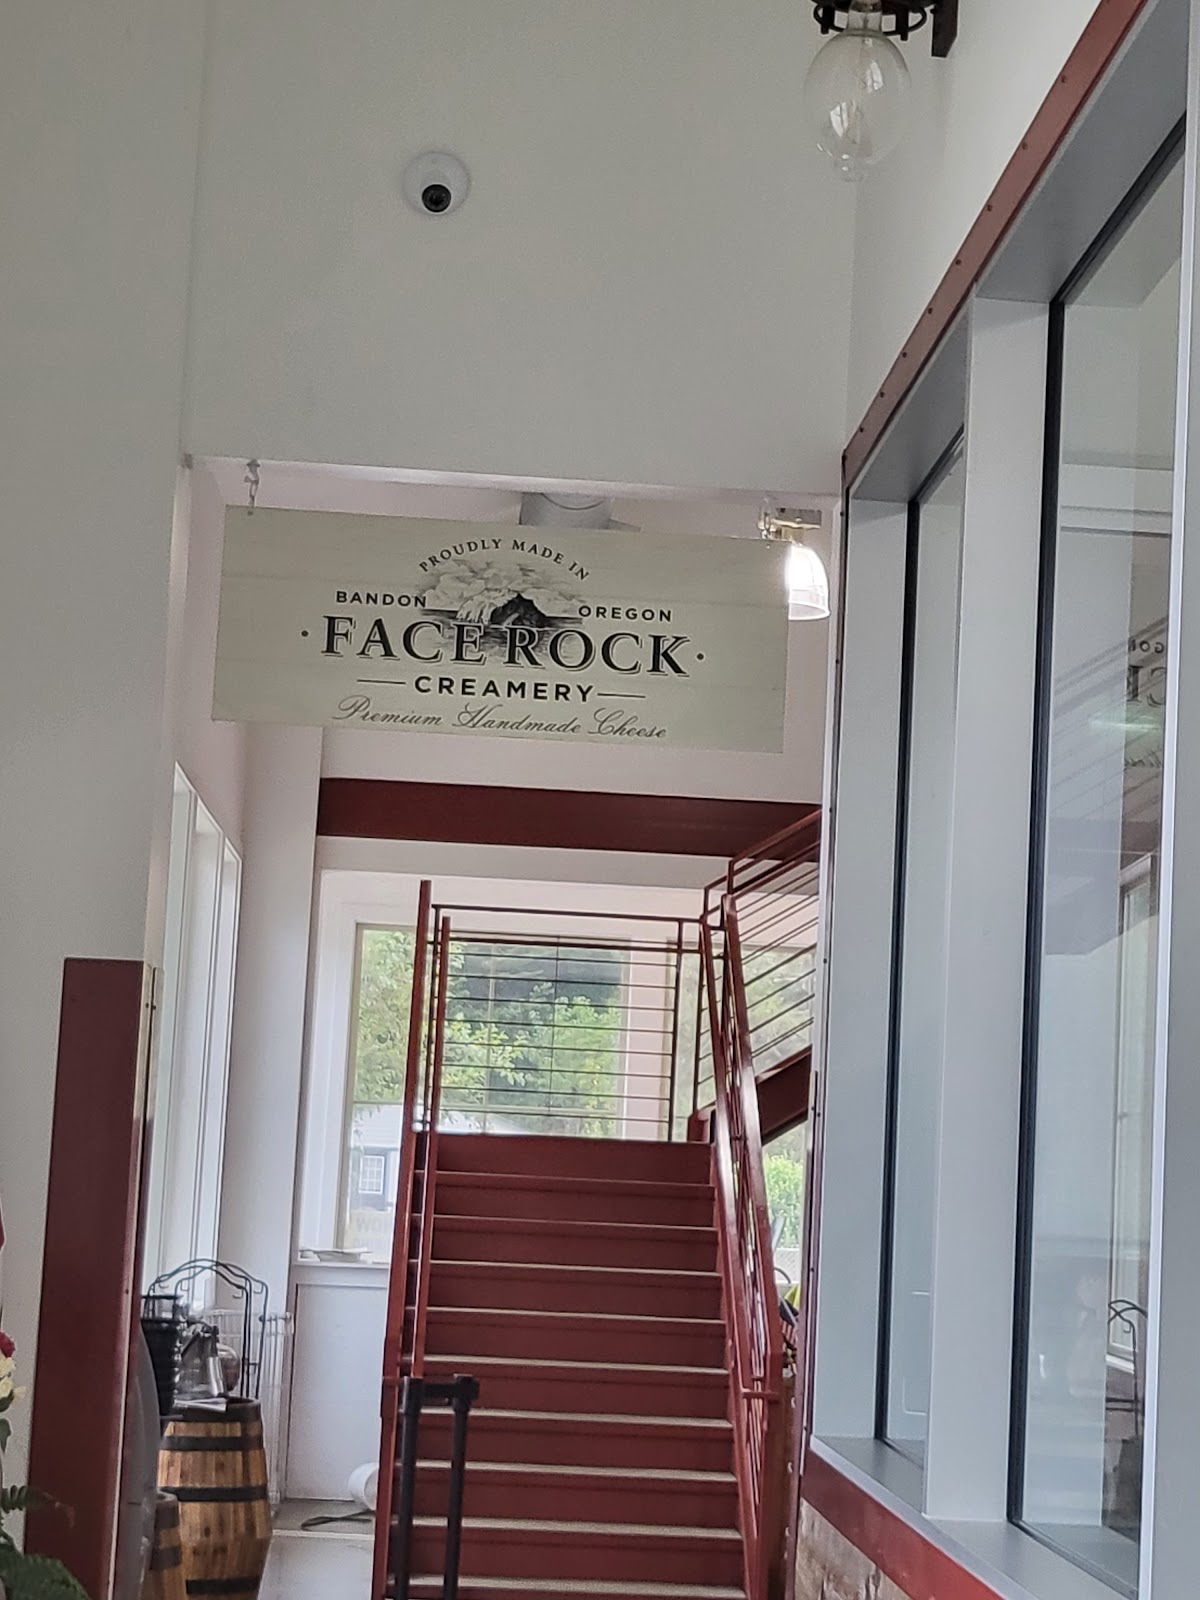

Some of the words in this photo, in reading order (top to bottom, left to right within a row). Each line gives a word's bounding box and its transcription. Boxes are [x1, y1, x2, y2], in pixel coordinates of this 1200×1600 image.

[419, 539, 502, 572] PROUDLY
[512, 540, 565, 564] MADE
[568, 561, 590, 581] IN
[336, 591, 427, 608] BANDON
[578, 605, 672, 623] OREGON
[321, 615, 487, 665] FACE
[503, 626, 691, 677] ROCK
[414, 676, 594, 702] CREAMERY
[332, 695, 443, 726] Premium
[452, 702, 581, 734] Handmade
[588, 708, 667, 738] Cheese
